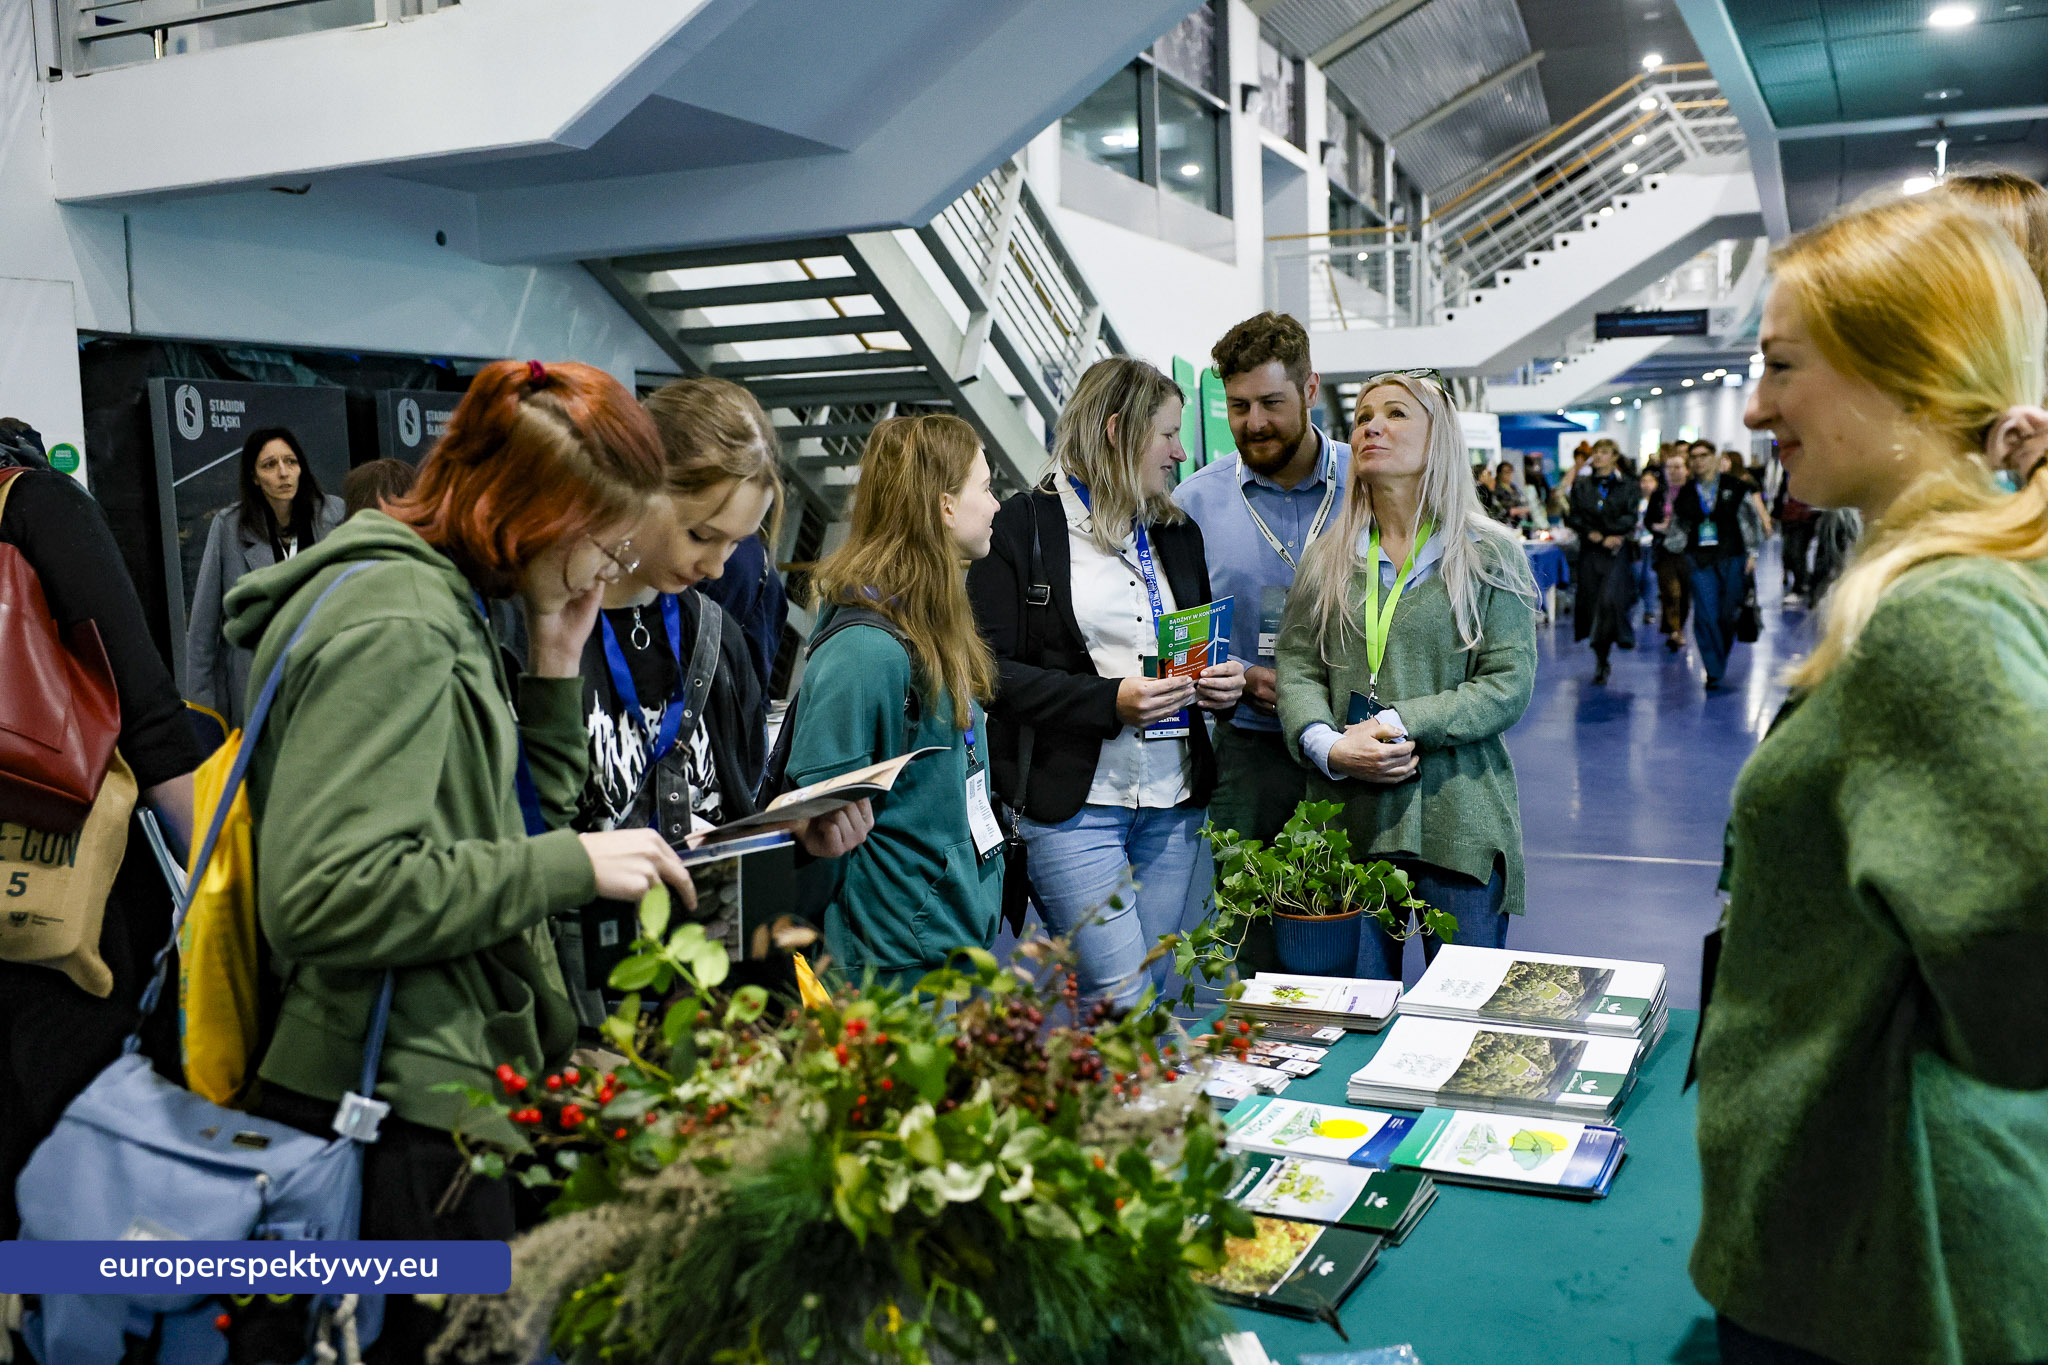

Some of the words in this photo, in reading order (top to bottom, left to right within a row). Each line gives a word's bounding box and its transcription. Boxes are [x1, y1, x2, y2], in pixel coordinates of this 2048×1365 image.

[209, 399, 246, 413] STADION
[210, 412, 241, 432] ŚLĄSKI
[6, 871, 30, 897] 5
